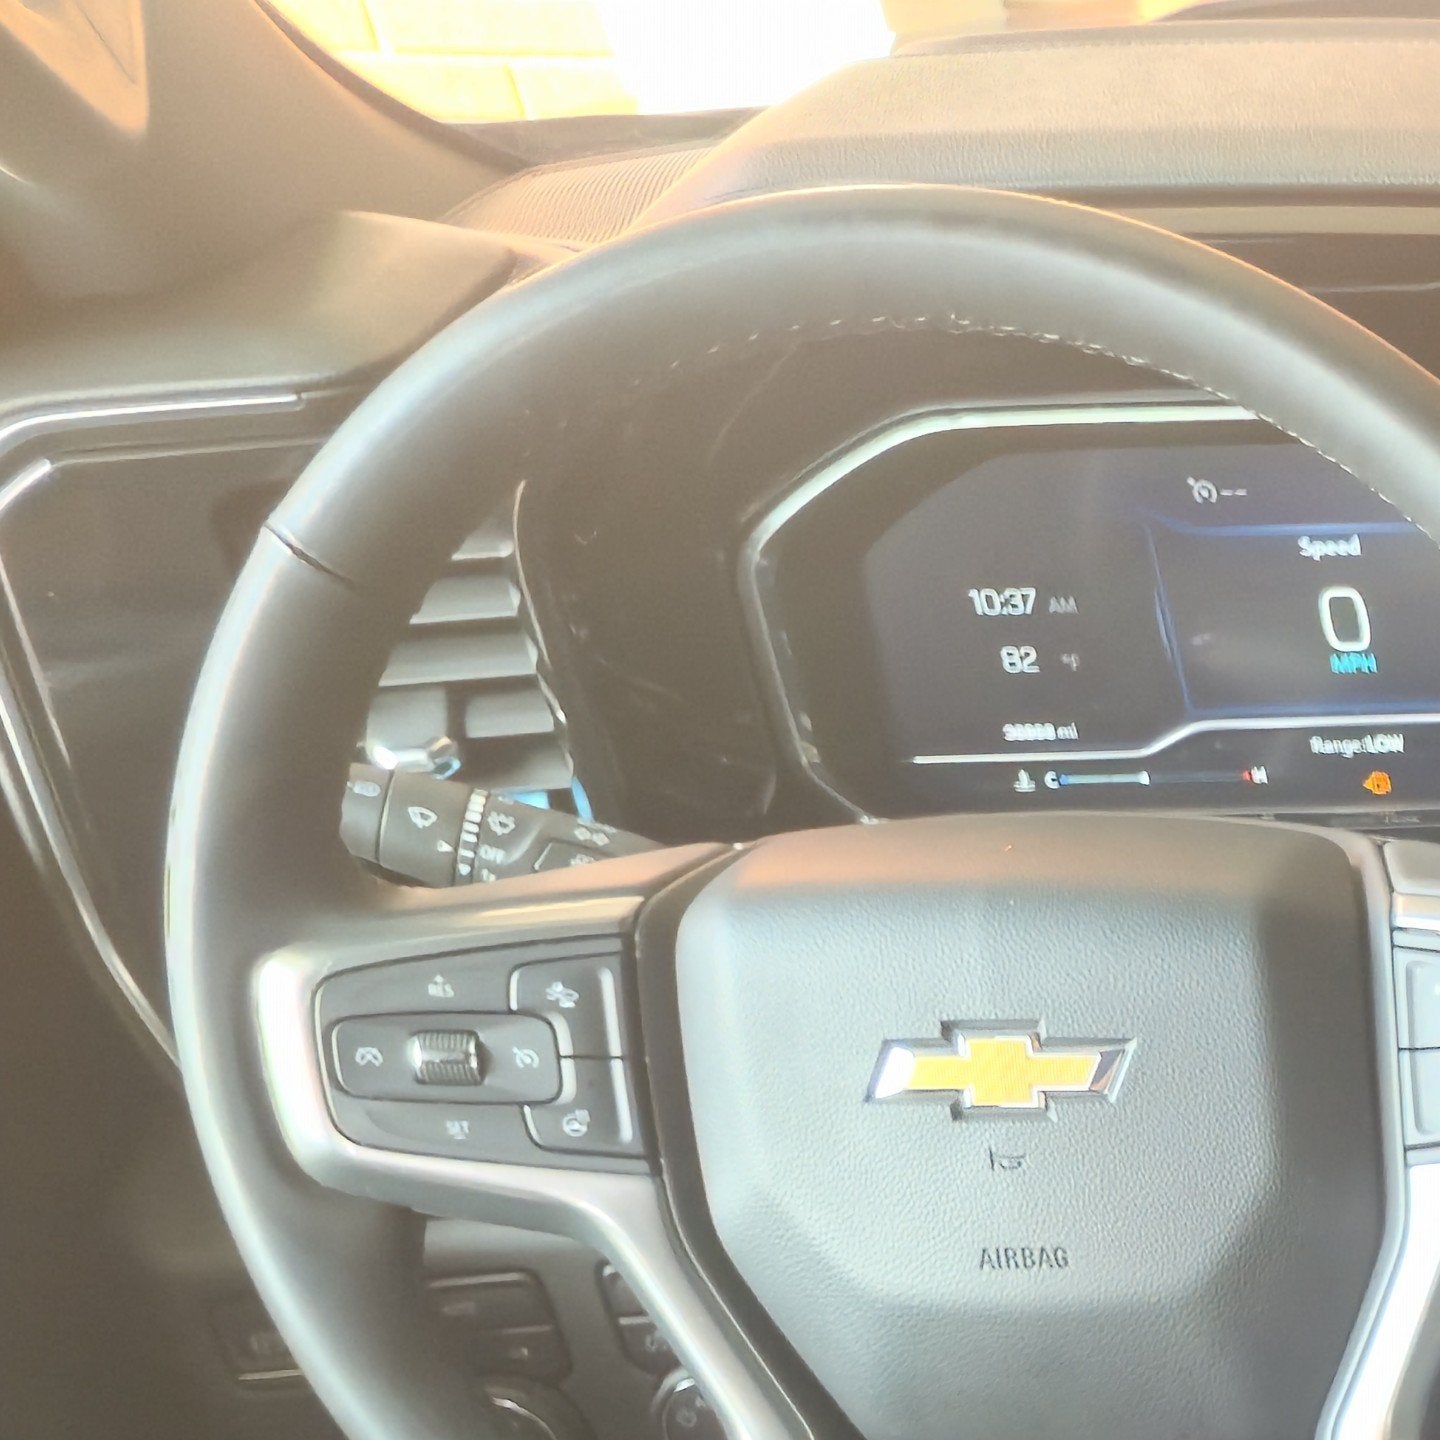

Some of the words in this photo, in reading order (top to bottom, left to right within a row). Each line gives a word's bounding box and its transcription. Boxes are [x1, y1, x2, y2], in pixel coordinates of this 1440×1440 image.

[1298, 533, 1361, 561] Speed
[969, 587, 1036, 615] 10:37
[1049, 596, 1079, 614] AM
[1318, 586, 1371, 652] 0
[1000, 645, 1040, 673] 82
[1330, 653, 1378, 674] MPH
[979, 1246, 1069, 1270] AIRBAG
